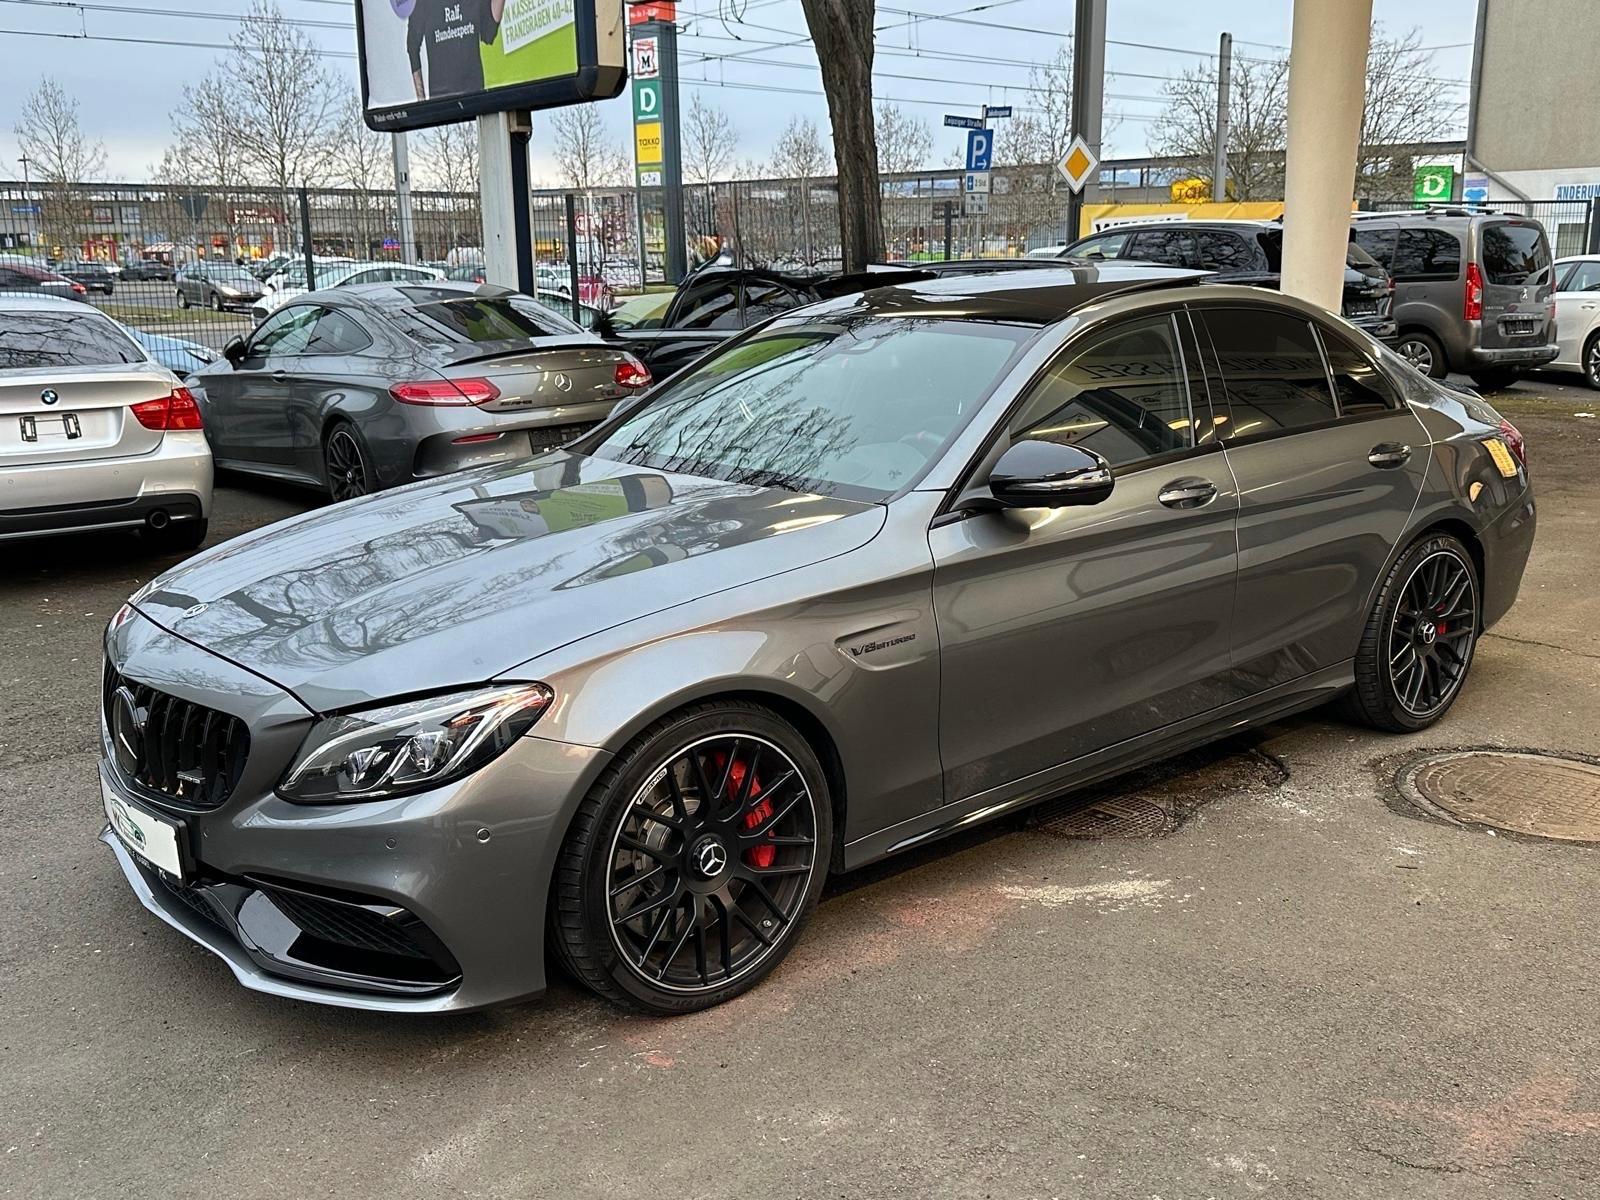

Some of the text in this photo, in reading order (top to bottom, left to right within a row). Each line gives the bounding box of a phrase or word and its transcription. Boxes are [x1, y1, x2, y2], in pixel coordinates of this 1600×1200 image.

[444, 3, 463, 23] Ralf,
[434, 21, 475, 44] Hundeexperte
[504, 6, 552, 46] FRANZGRABEN
[639, 86, 657, 113] D
[944, 116, 983, 129] Leipziger Straße
[971, 135, 987, 169] P
[1422, 174, 1446, 196] D
[850, 640, 876, 657] V8
